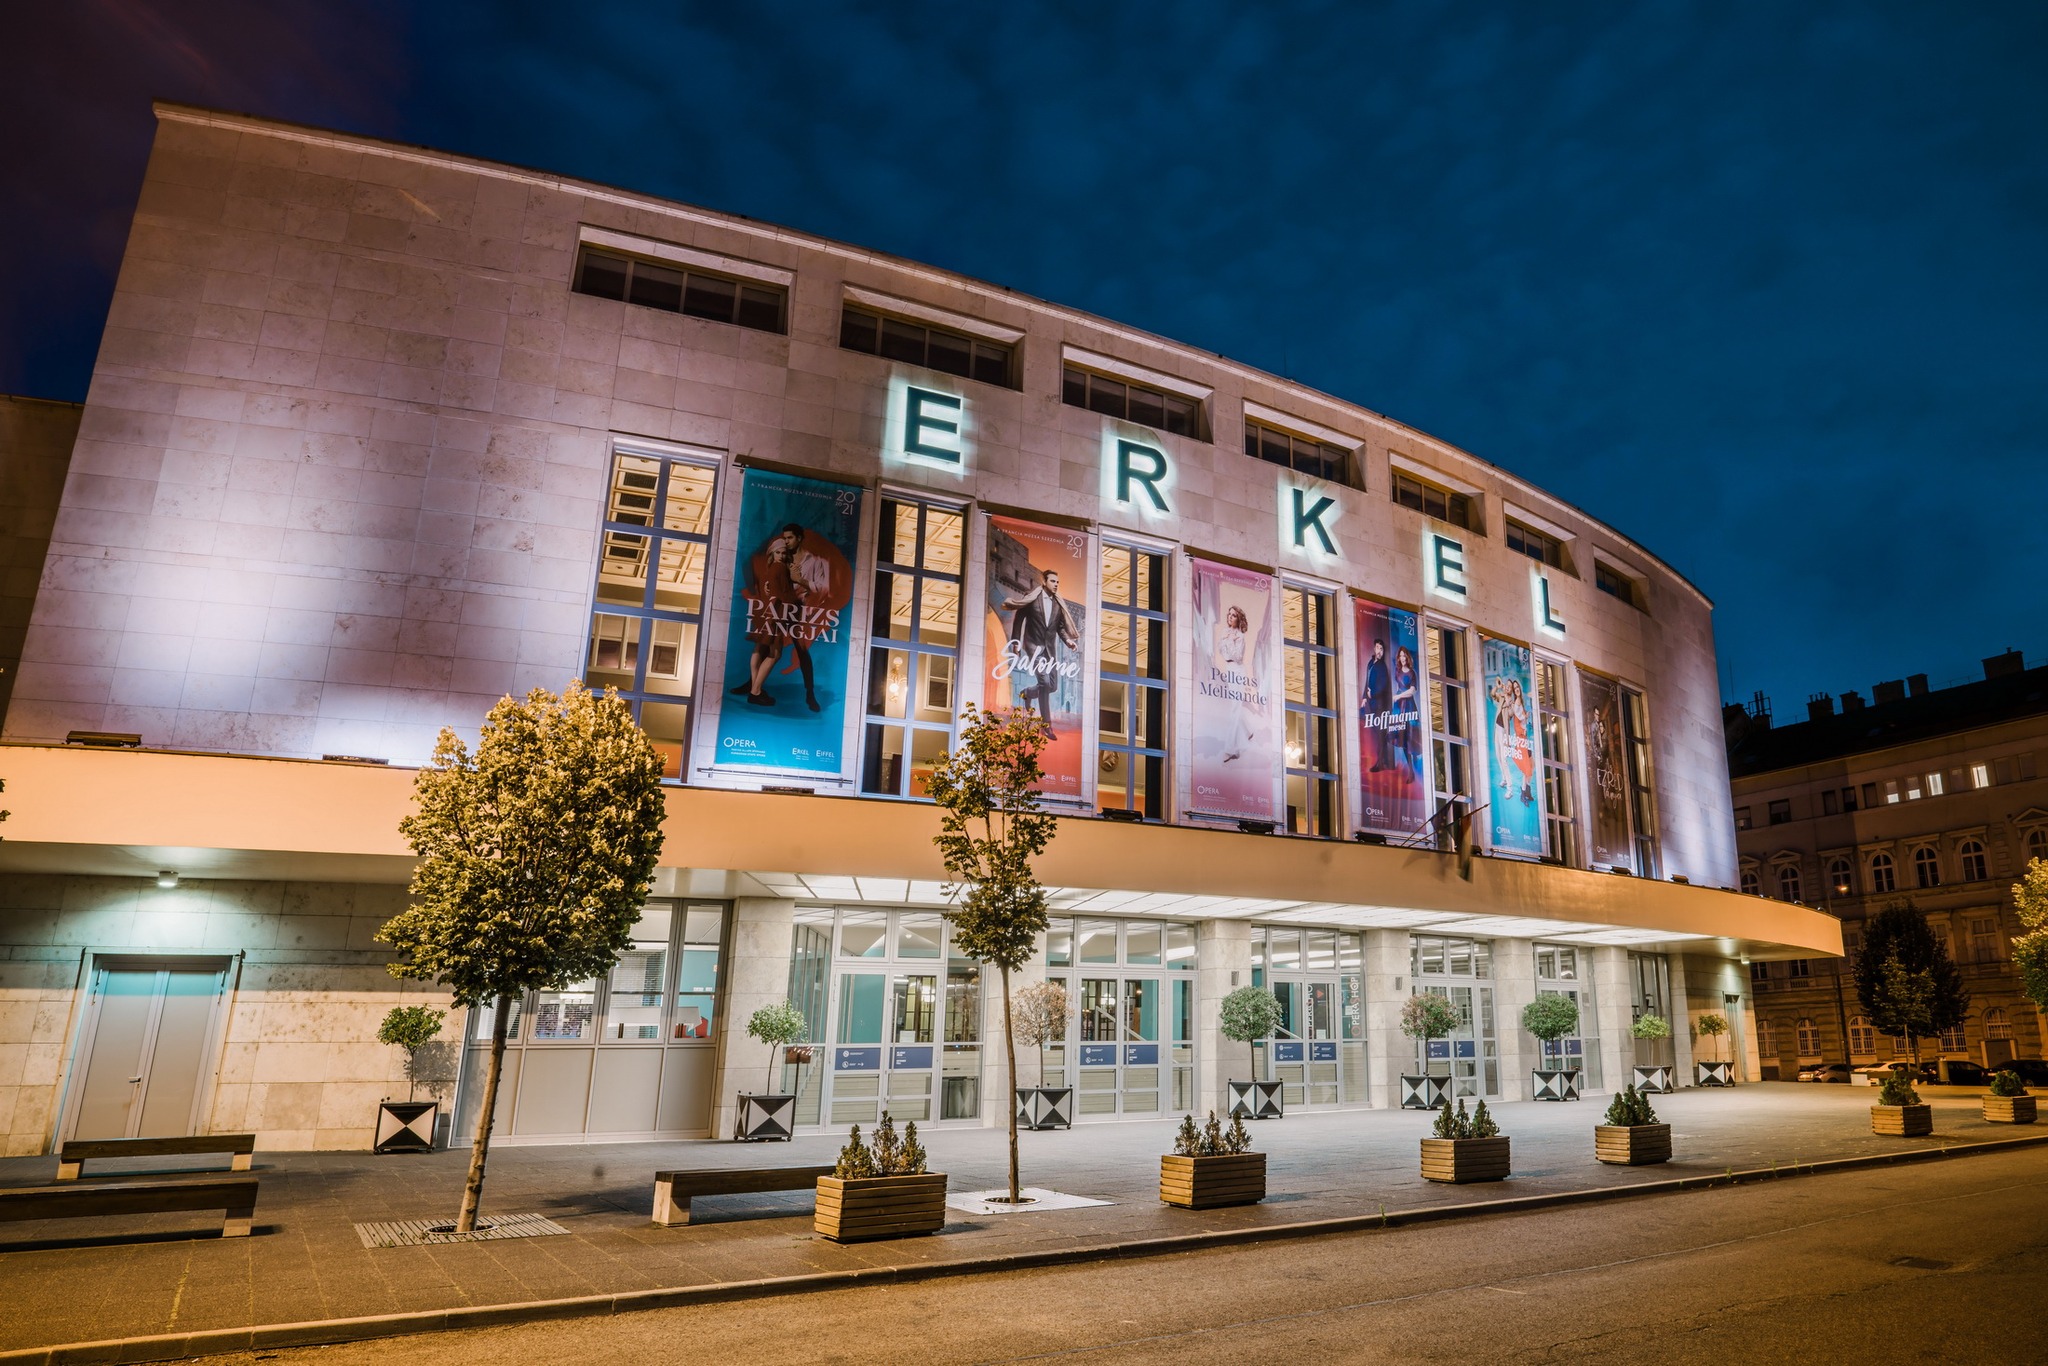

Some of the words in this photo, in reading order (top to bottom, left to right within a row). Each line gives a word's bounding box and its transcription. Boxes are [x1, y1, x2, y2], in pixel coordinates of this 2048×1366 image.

[836, 489, 856, 504] 20
[842, 503, 853, 515] 21
[904, 385, 1567, 635] ERKEL
[1067, 534, 1084, 548] 20
[1072, 547, 1082, 558] 21
[1254, 576, 1268, 589] 20
[746, 596, 840, 628] PÁRIZS
[1404, 615, 1416, 627] 20
[745, 617, 838, 643] LÁNGJAI
[991, 639, 1081, 680] Salome
[1363, 710, 1419, 730] Hoffmann
[723, 737, 757, 748] OPERA
[792, 747, 810, 756] ERKEL
[816, 749, 835, 759] EIFFEL
[1596, 768, 1624, 791] EZRED
[1197, 785, 1220, 795] OPERA
[1365, 807, 1385, 816] OPERA
